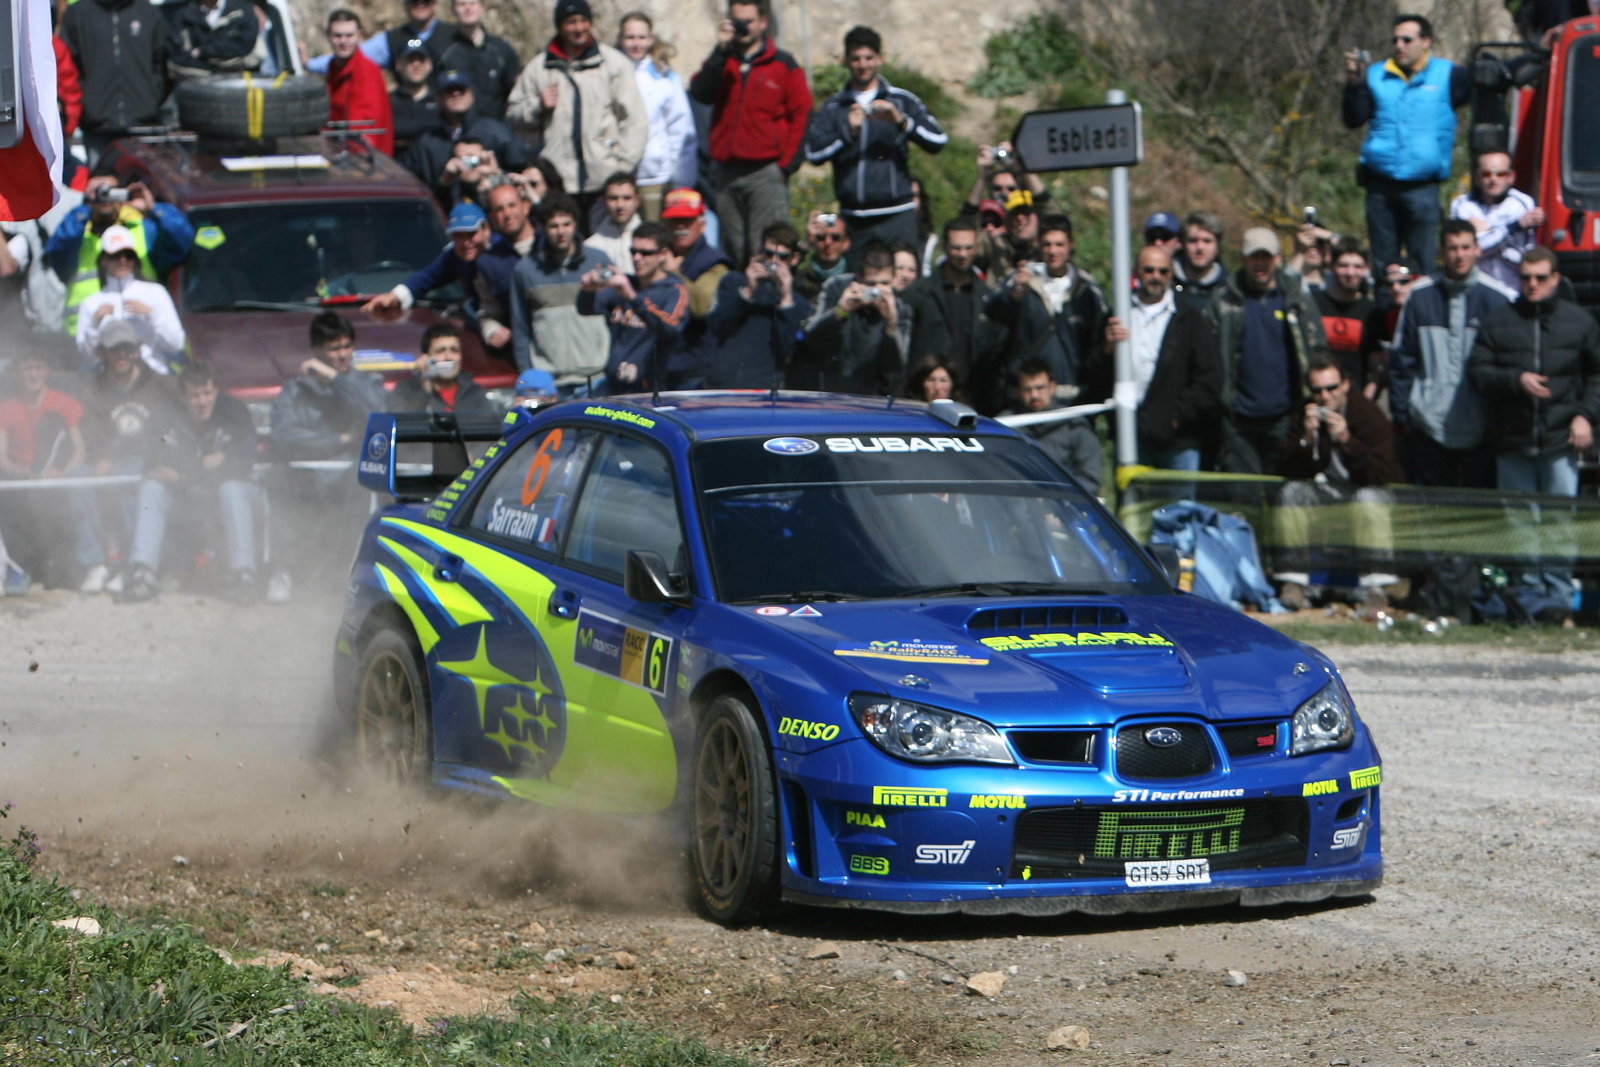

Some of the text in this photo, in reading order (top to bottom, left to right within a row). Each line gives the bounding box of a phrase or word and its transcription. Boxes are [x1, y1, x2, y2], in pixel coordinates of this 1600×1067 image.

[1047, 122, 1130, 154] Esblada
[583, 406, 656, 429] subaru-global.com
[825, 437, 985, 453] SUBARU
[360, 461, 387, 475] SUBARU
[520, 428, 563, 507] 6
[487, 497, 540, 541] Sarrazin
[980, 632, 1167, 647] SUBARU
[992, 641, 1057, 651] WORLD
[649, 638, 663, 689] 6
[778, 717, 840, 741] DENSO
[1349, 766, 1379, 789] PIRELLI
[873, 785, 948, 807] PIRELLI
[1112, 788, 1244, 802] STI Performance
[1302, 779, 1339, 797] MOTUL
[969, 795, 1026, 809] MOTUL
[846, 811, 886, 828] PIAA
[1094, 806, 1245, 858] PIRELLI
[850, 855, 888, 874] BBS
[1130, 864, 1206, 882] GT55 SRT
